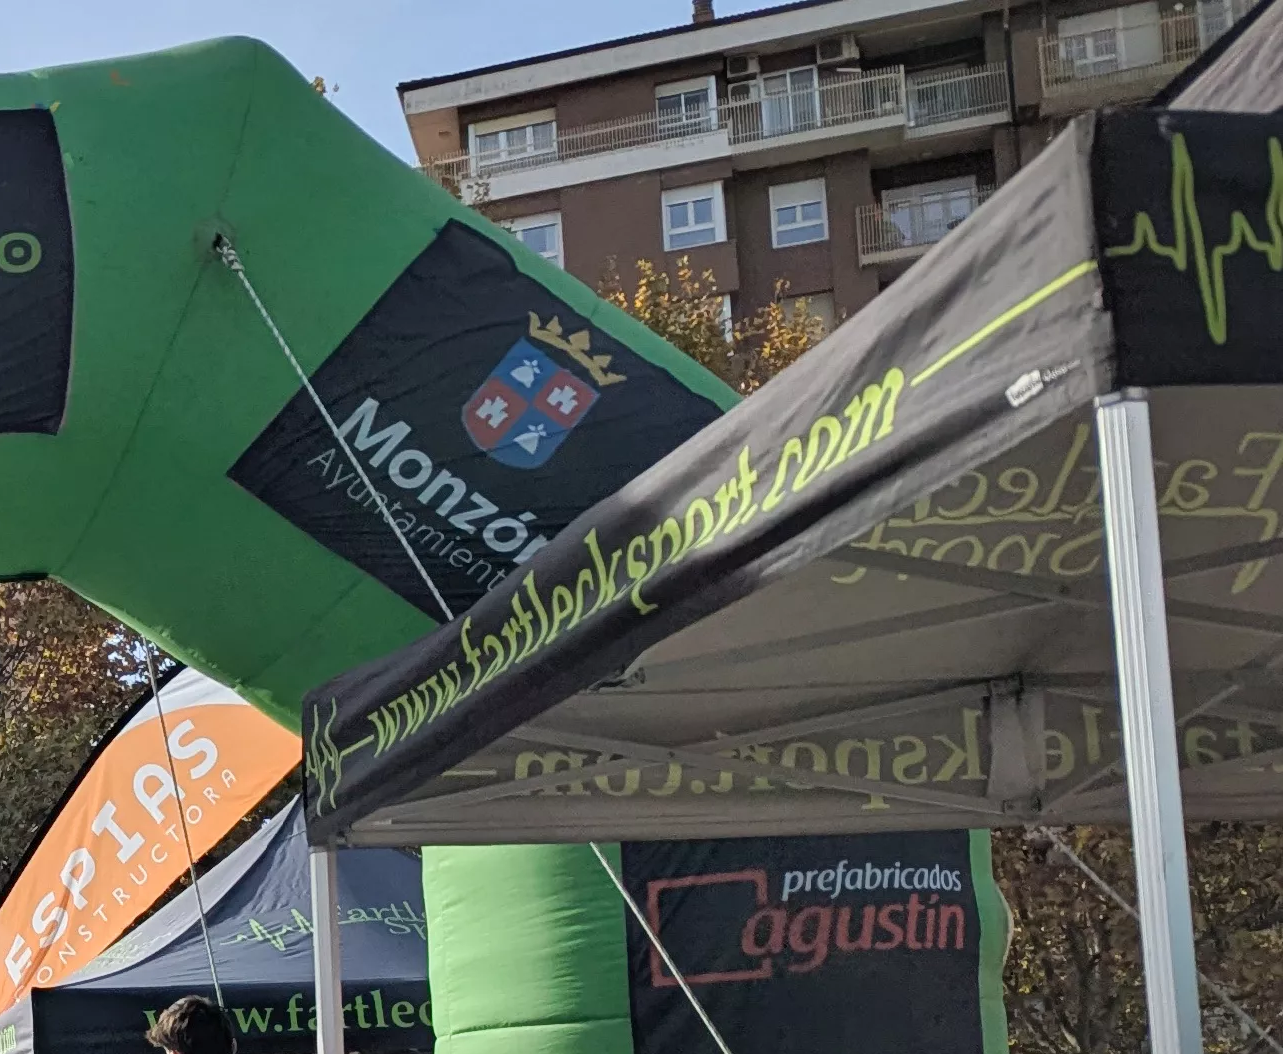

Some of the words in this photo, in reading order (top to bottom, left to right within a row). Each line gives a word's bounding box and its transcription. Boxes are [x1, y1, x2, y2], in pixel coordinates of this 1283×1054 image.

[307, 446, 507, 592] Ayuntamient
[4, 718, 222, 992] ESPIAS
[25, 767, 238, 1000] ONSTRUCTORA
[781, 859, 963, 902] prefabricados
[741, 892, 965, 975] agustín
